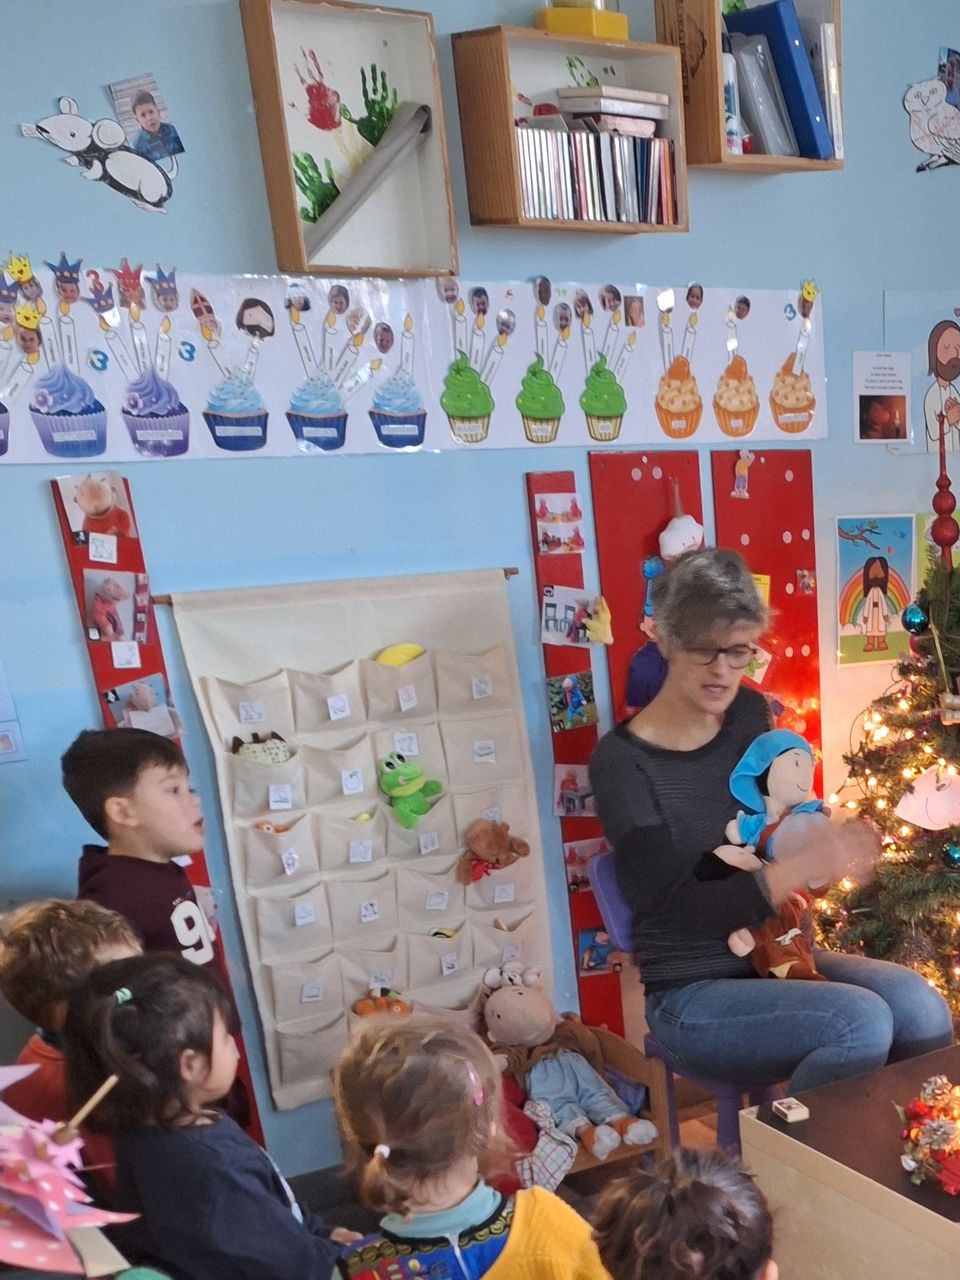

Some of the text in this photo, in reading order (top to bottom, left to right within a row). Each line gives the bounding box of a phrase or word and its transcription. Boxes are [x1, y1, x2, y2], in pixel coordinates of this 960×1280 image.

[85, 269, 105, 295] 3
[89, 349, 109, 371] 3
[178, 340, 196, 362] 3
[170, 900, 214, 966] 9
